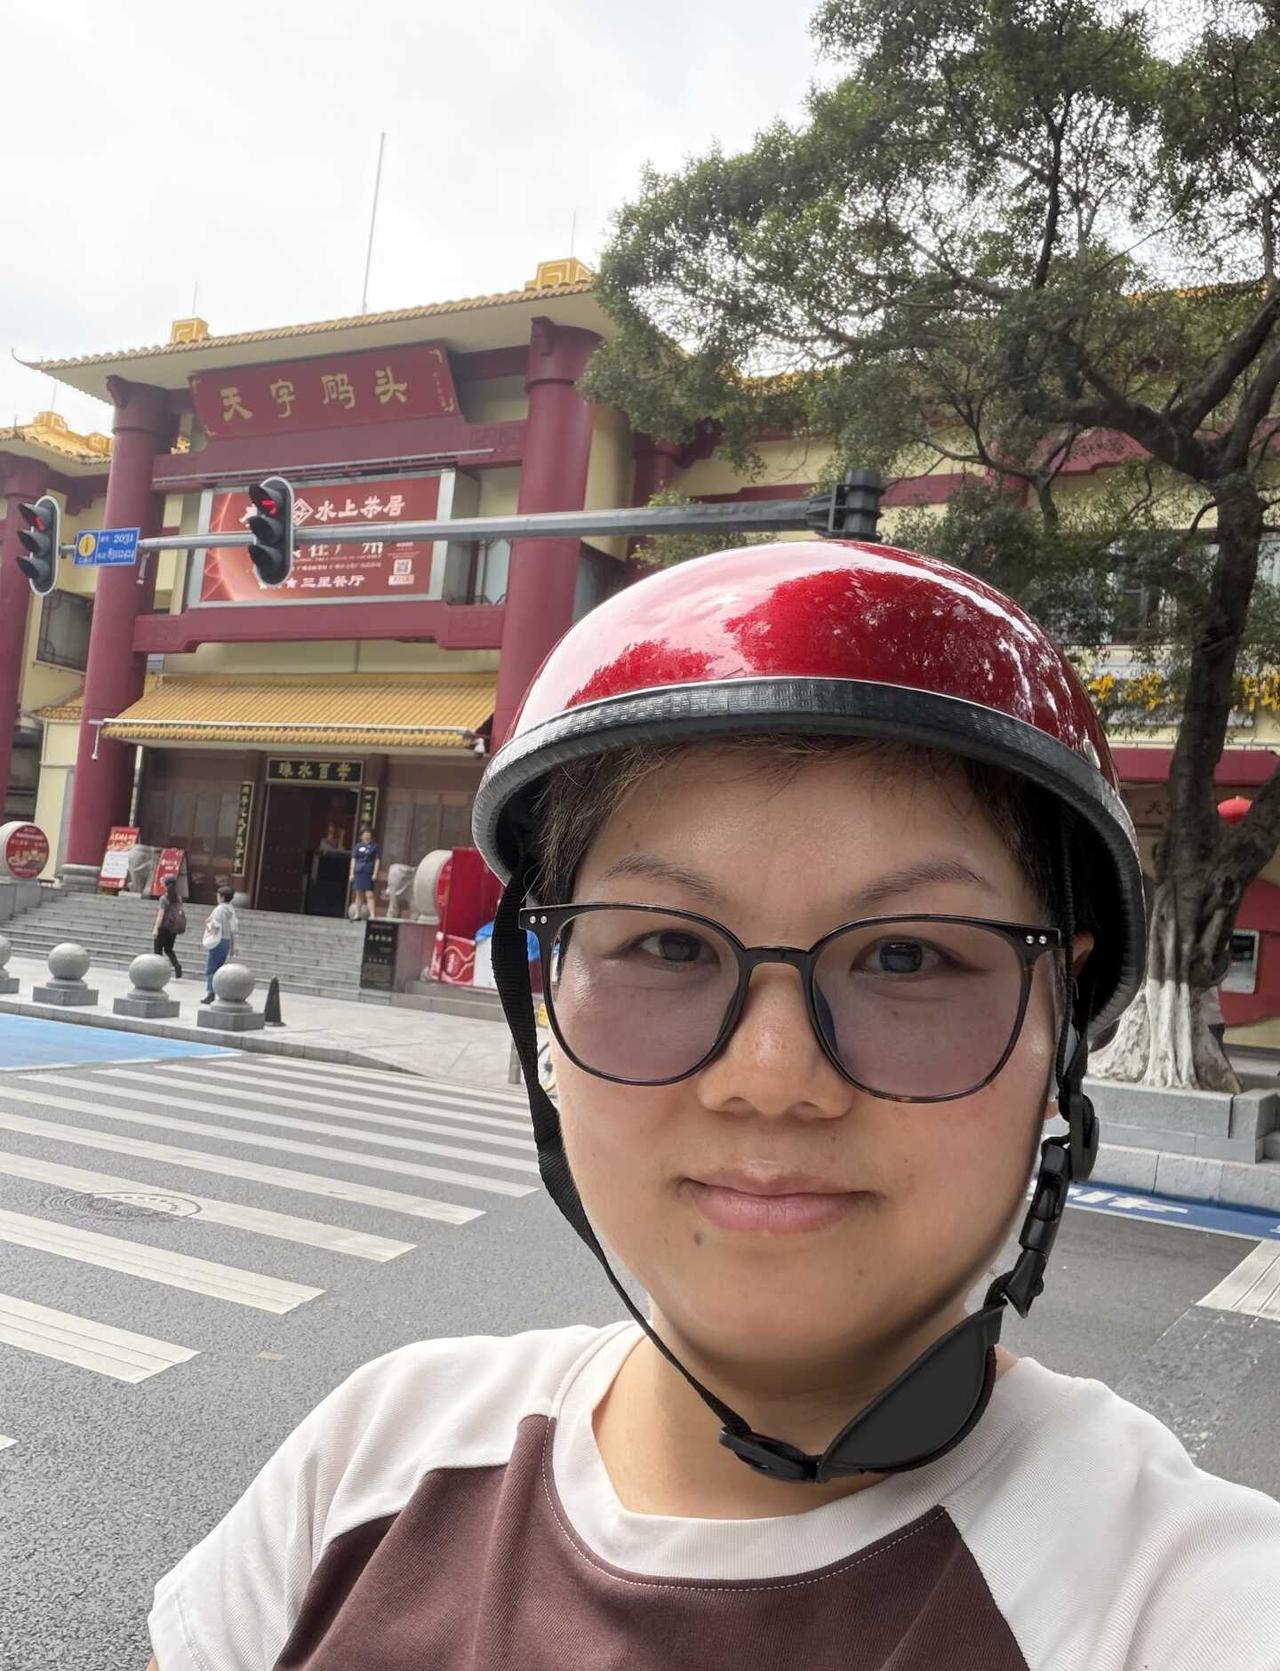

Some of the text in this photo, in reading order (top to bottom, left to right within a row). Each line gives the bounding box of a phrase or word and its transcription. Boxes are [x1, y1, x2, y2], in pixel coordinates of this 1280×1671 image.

[218, 366, 408, 421] 天字码头
[315, 495, 406, 522] 水上茶居
[300, 575, 366, 588] 三星餐厅
